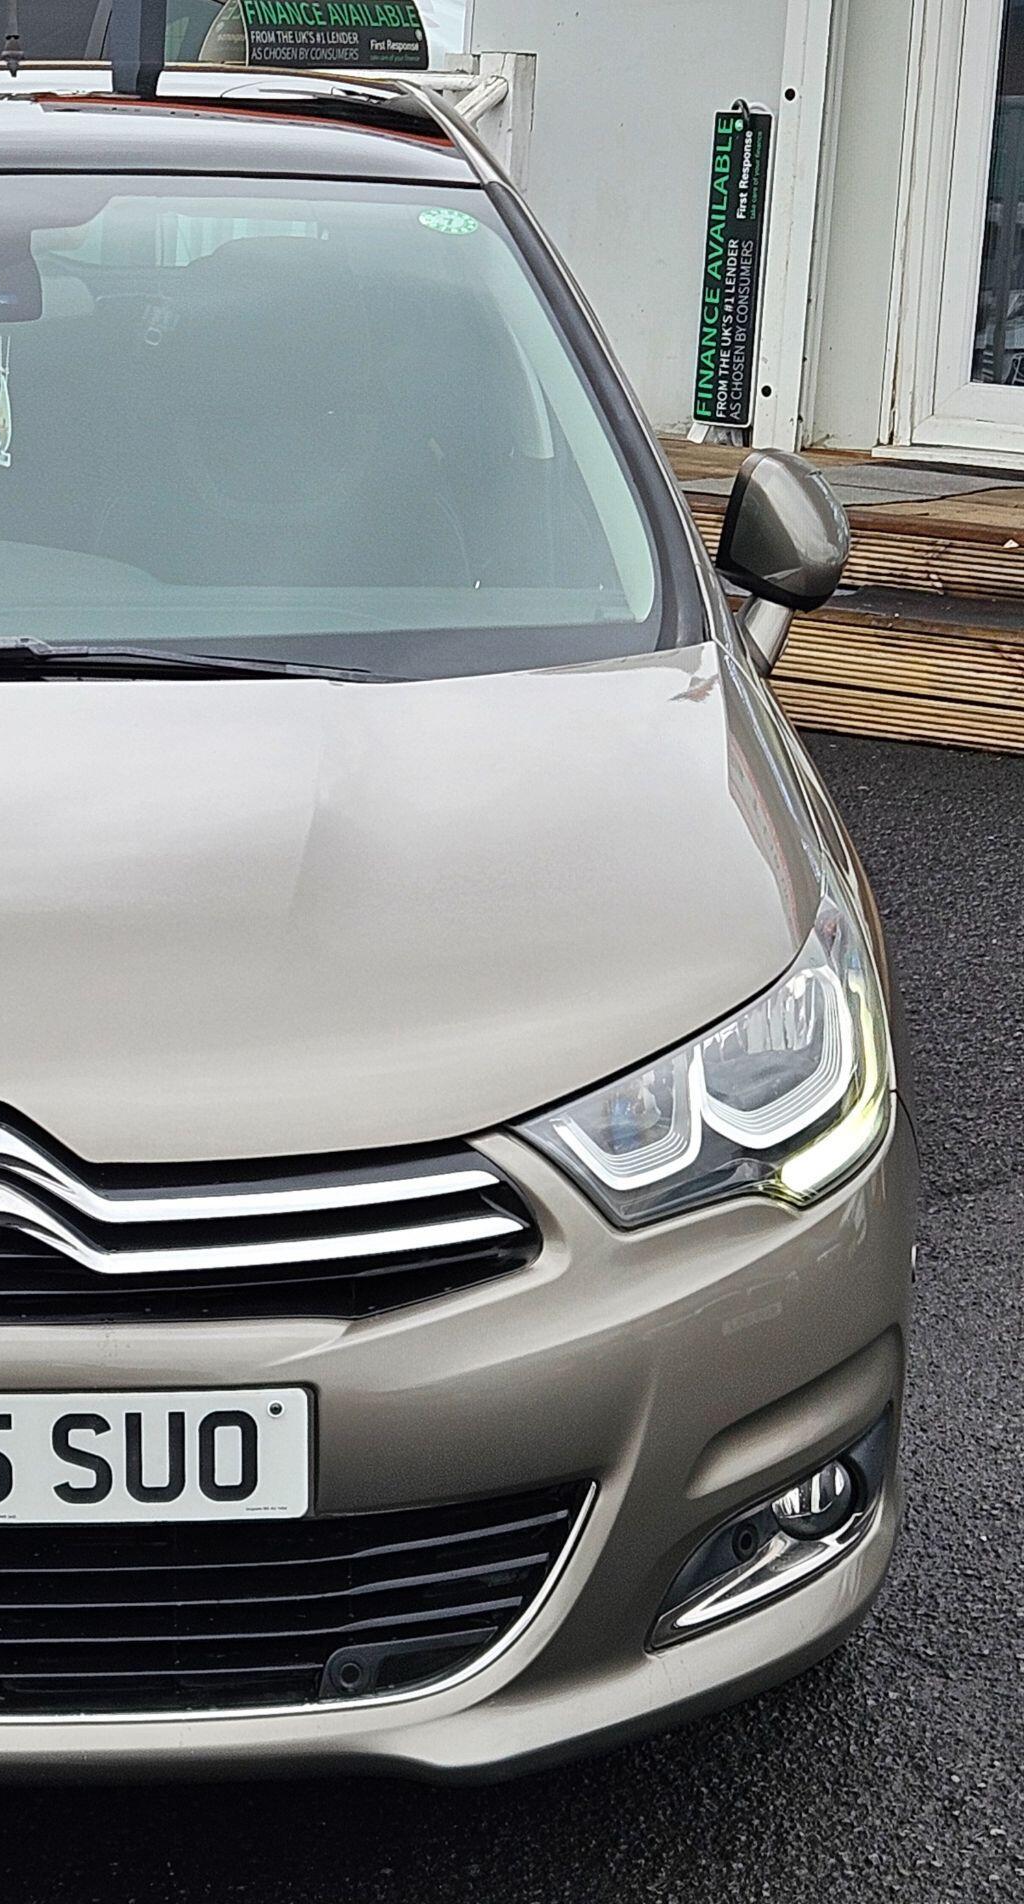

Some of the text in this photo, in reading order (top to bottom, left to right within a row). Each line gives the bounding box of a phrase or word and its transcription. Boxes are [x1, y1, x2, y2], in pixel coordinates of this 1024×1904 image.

[244, 0, 420, 27] FINANCE AVAILABLE
[251, 31, 275, 43] FROM
[276, 31, 294, 43] THE
[295, 31, 315, 44] UK'S
[327, 32, 359, 44] LENDER
[251, 47, 263, 60] AS
[263, 47, 298, 60] CHOSEN
[299, 47, 310, 60] BY
[310, 47, 359, 60] CONSUMERS
[370, 39, 419, 52] First Response
[736, 130, 753, 219] First Response
[696, 118, 734, 416] FINANCE AVAILABLE
[716, 239, 739, 418] FROM THE UK'S #1 LENDER
[729, 240, 754, 420] AS CHOSEN BY CONSUMERS
[52, 1410, 258, 1504] SUO
